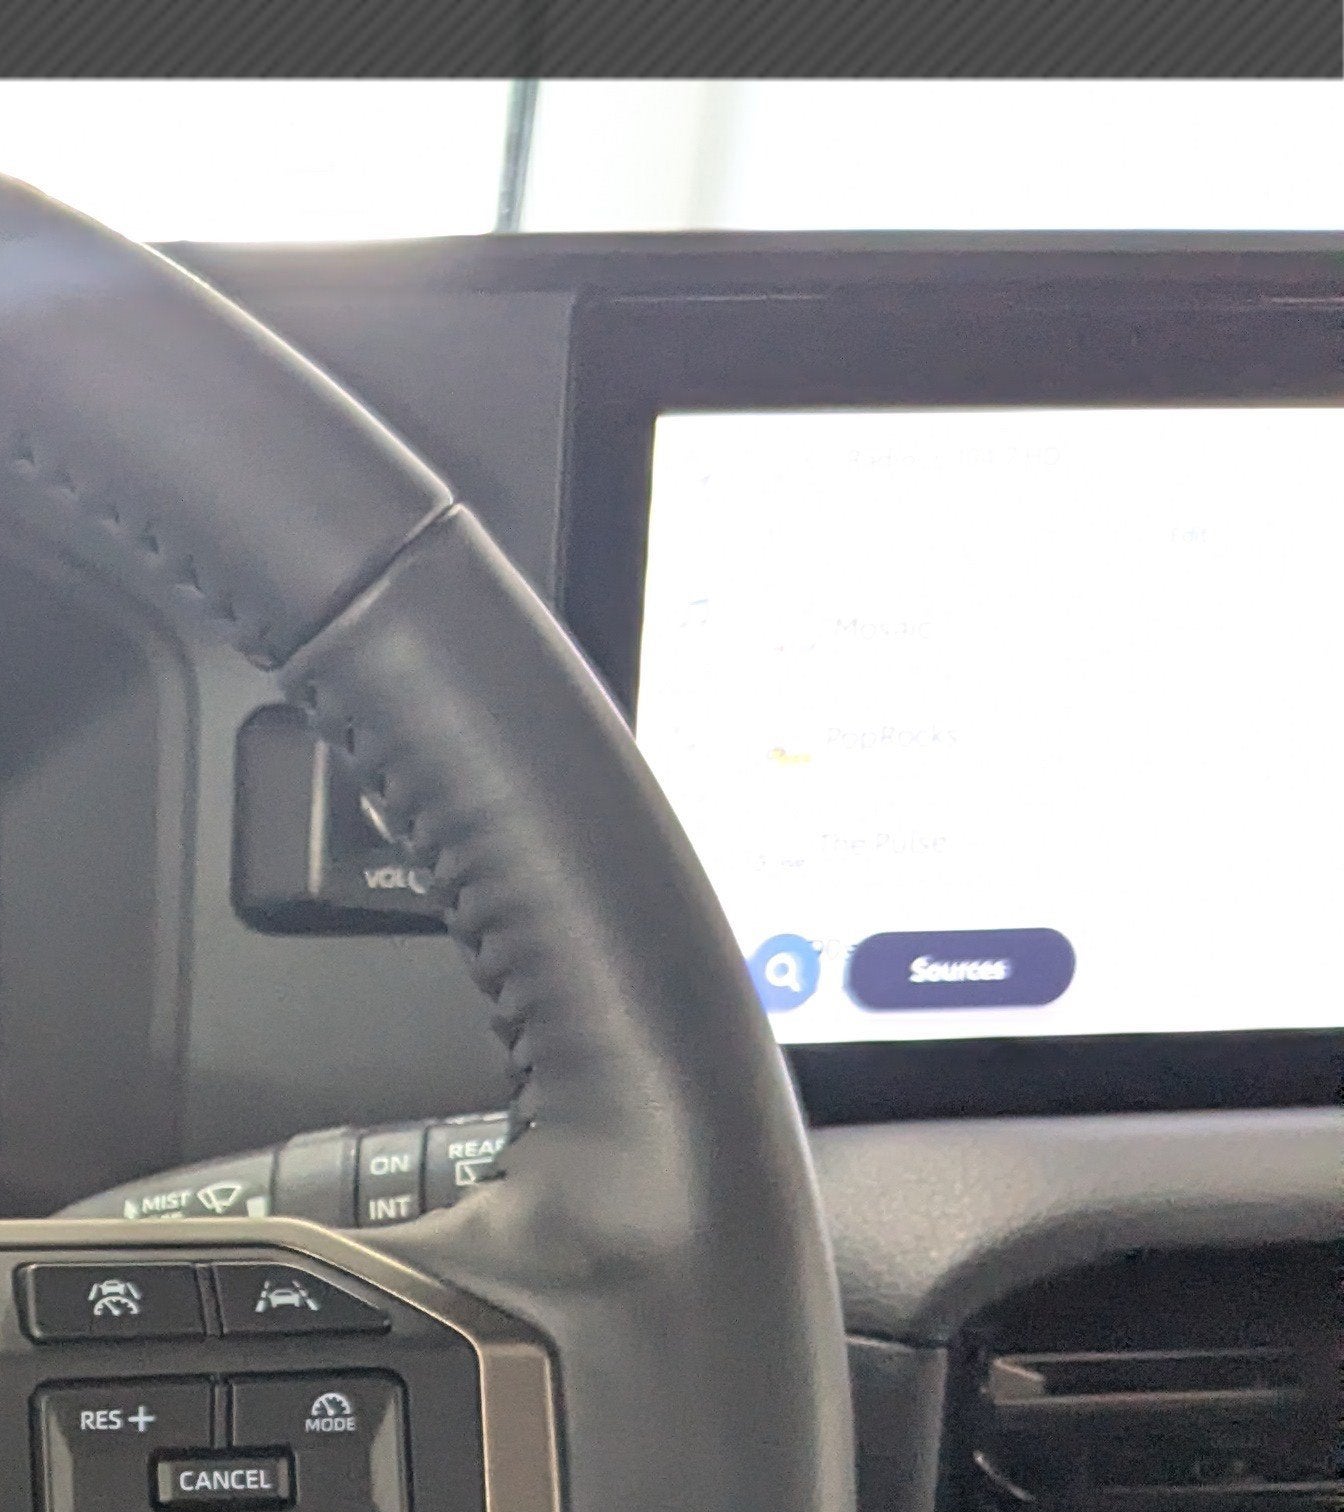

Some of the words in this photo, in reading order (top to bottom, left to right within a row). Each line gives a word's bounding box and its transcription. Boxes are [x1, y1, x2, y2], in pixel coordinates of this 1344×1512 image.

[908, 955, 1012, 983] Sources
[370, 1155, 410, 1176] ON
[141, 1192, 191, 1213] MIST
[368, 1197, 411, 1220] INT
[79, 1409, 124, 1431] RES
[305, 1416, 356, 1433] MODE
[178, 1468, 273, 1491] CANCEL
